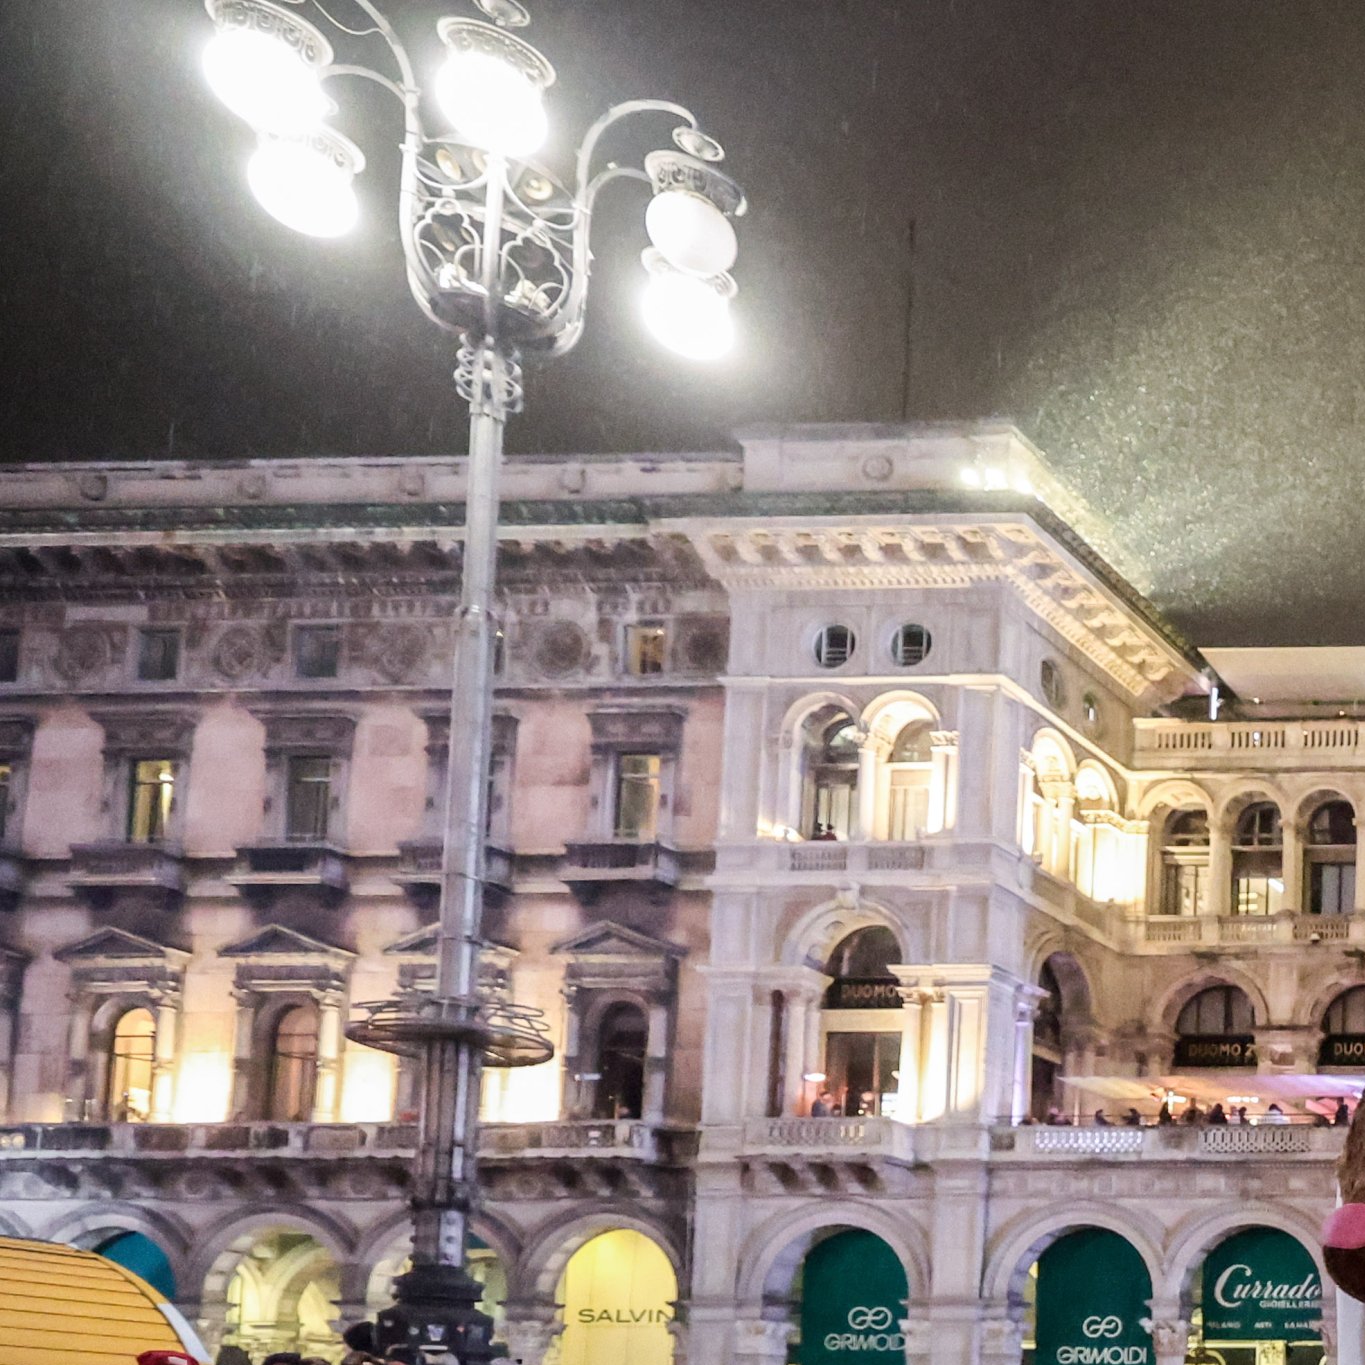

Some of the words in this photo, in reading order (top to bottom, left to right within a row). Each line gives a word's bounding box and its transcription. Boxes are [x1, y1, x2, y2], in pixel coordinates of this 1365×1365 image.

[1189, 1042, 1241, 1056] DUOMO
[1214, 1264, 1322, 1308] Currado
[1056, 1345, 1148, 1365] GRIMOLDI
